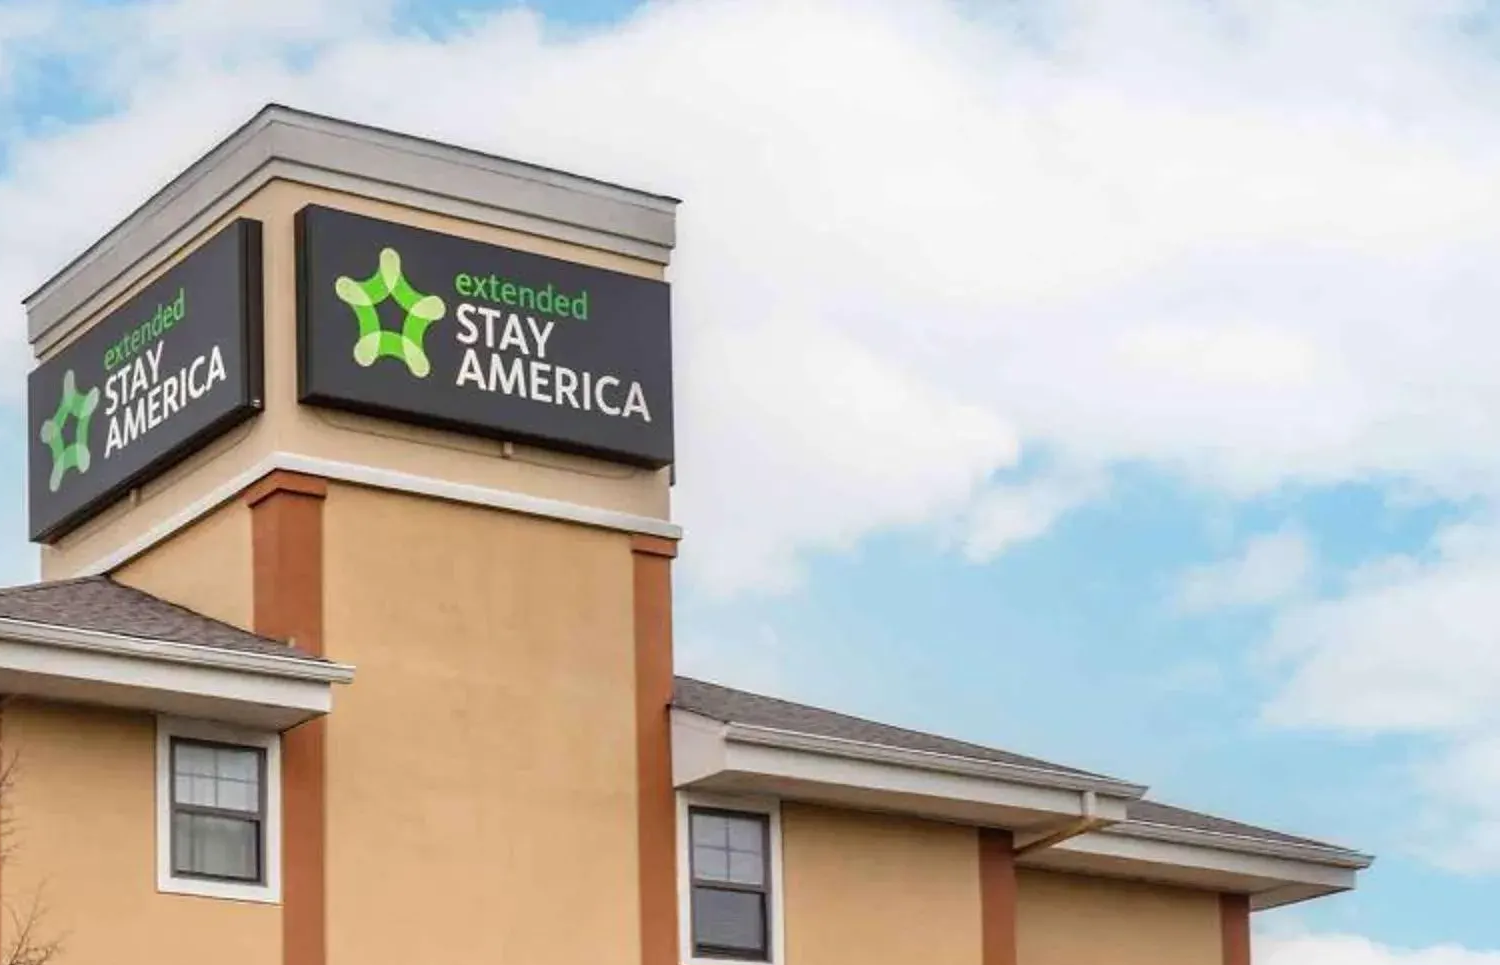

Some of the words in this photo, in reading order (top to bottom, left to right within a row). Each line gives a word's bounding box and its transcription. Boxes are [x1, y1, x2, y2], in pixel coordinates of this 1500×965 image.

[105, 288, 185, 370] extended
[455, 273, 588, 320] extended
[456, 303, 554, 358] STAY
[104, 345, 227, 459] AMERICA
[105, 340, 164, 416] STAY
[456, 348, 652, 423] AMERICA
